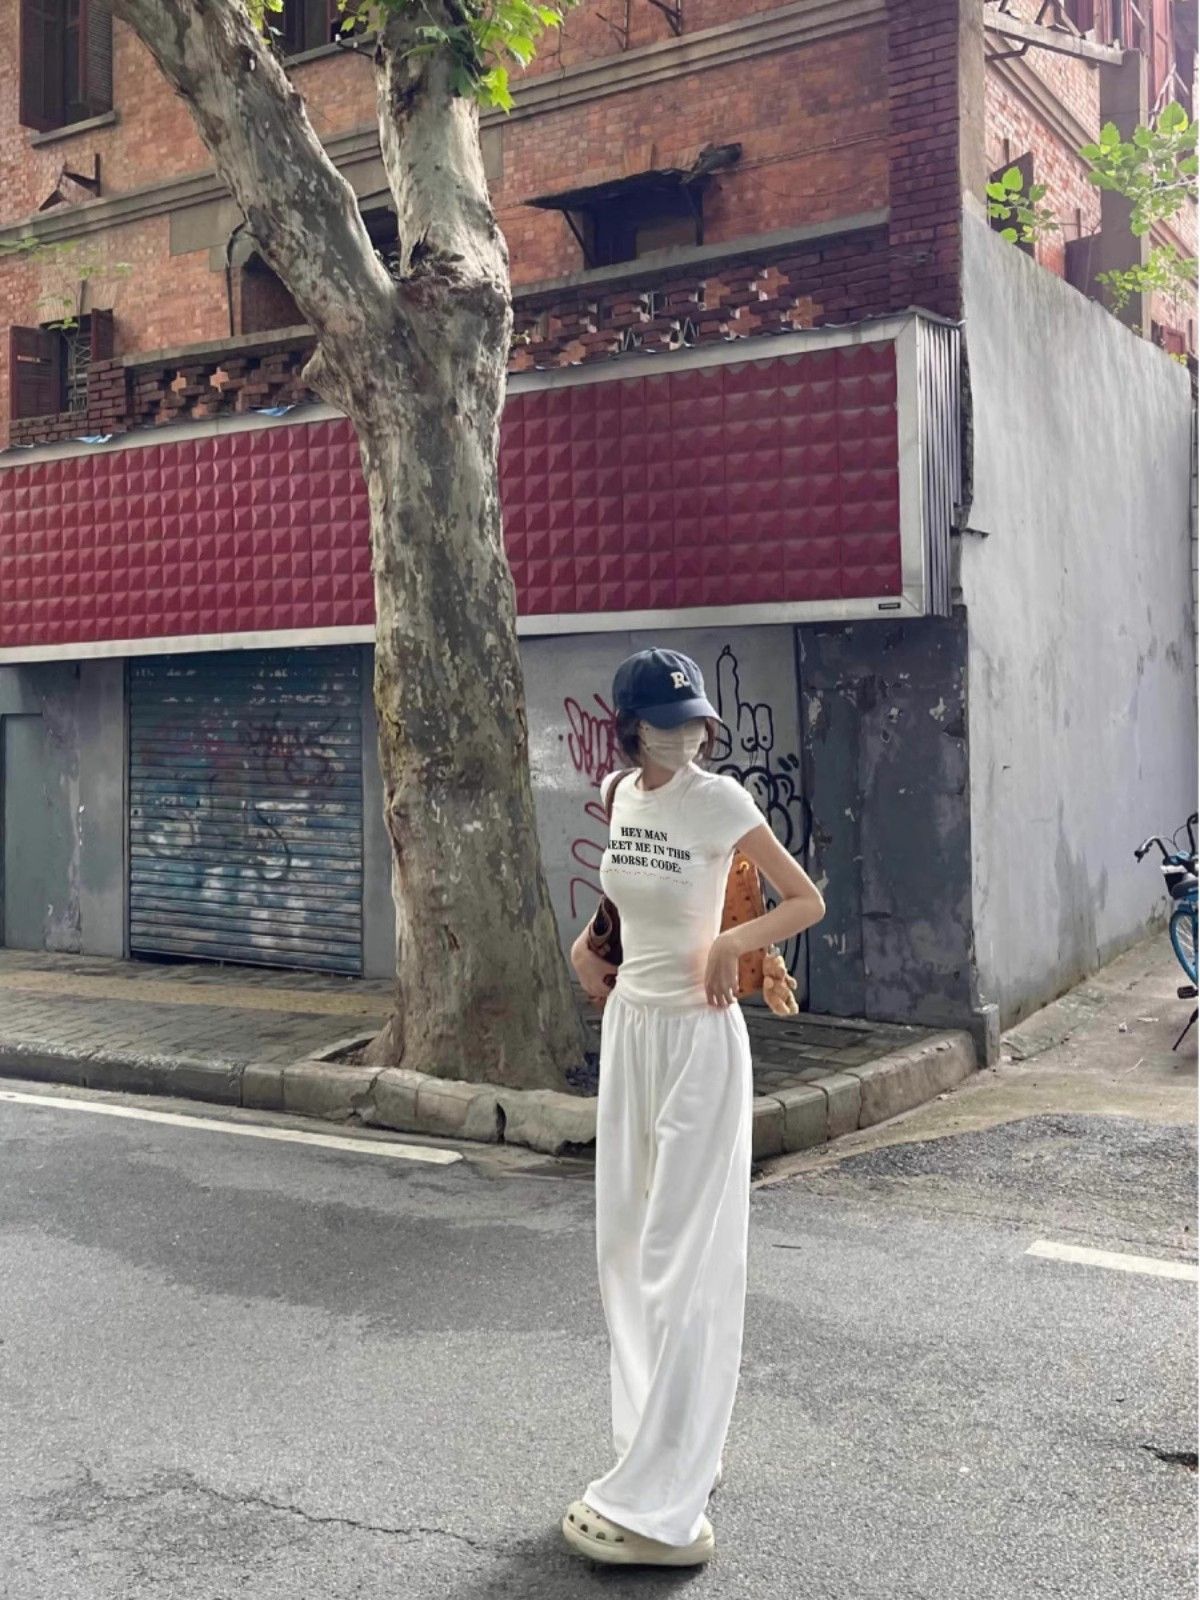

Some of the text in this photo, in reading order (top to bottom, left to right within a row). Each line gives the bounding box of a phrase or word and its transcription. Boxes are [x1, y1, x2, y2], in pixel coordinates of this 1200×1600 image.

[621, 827, 668, 842] HEY MAN
[636, 842, 651, 853] ME
[654, 845, 665, 855] IN
[667, 847, 691, 860] THIS
[612, 854, 648, 867] MORSE
